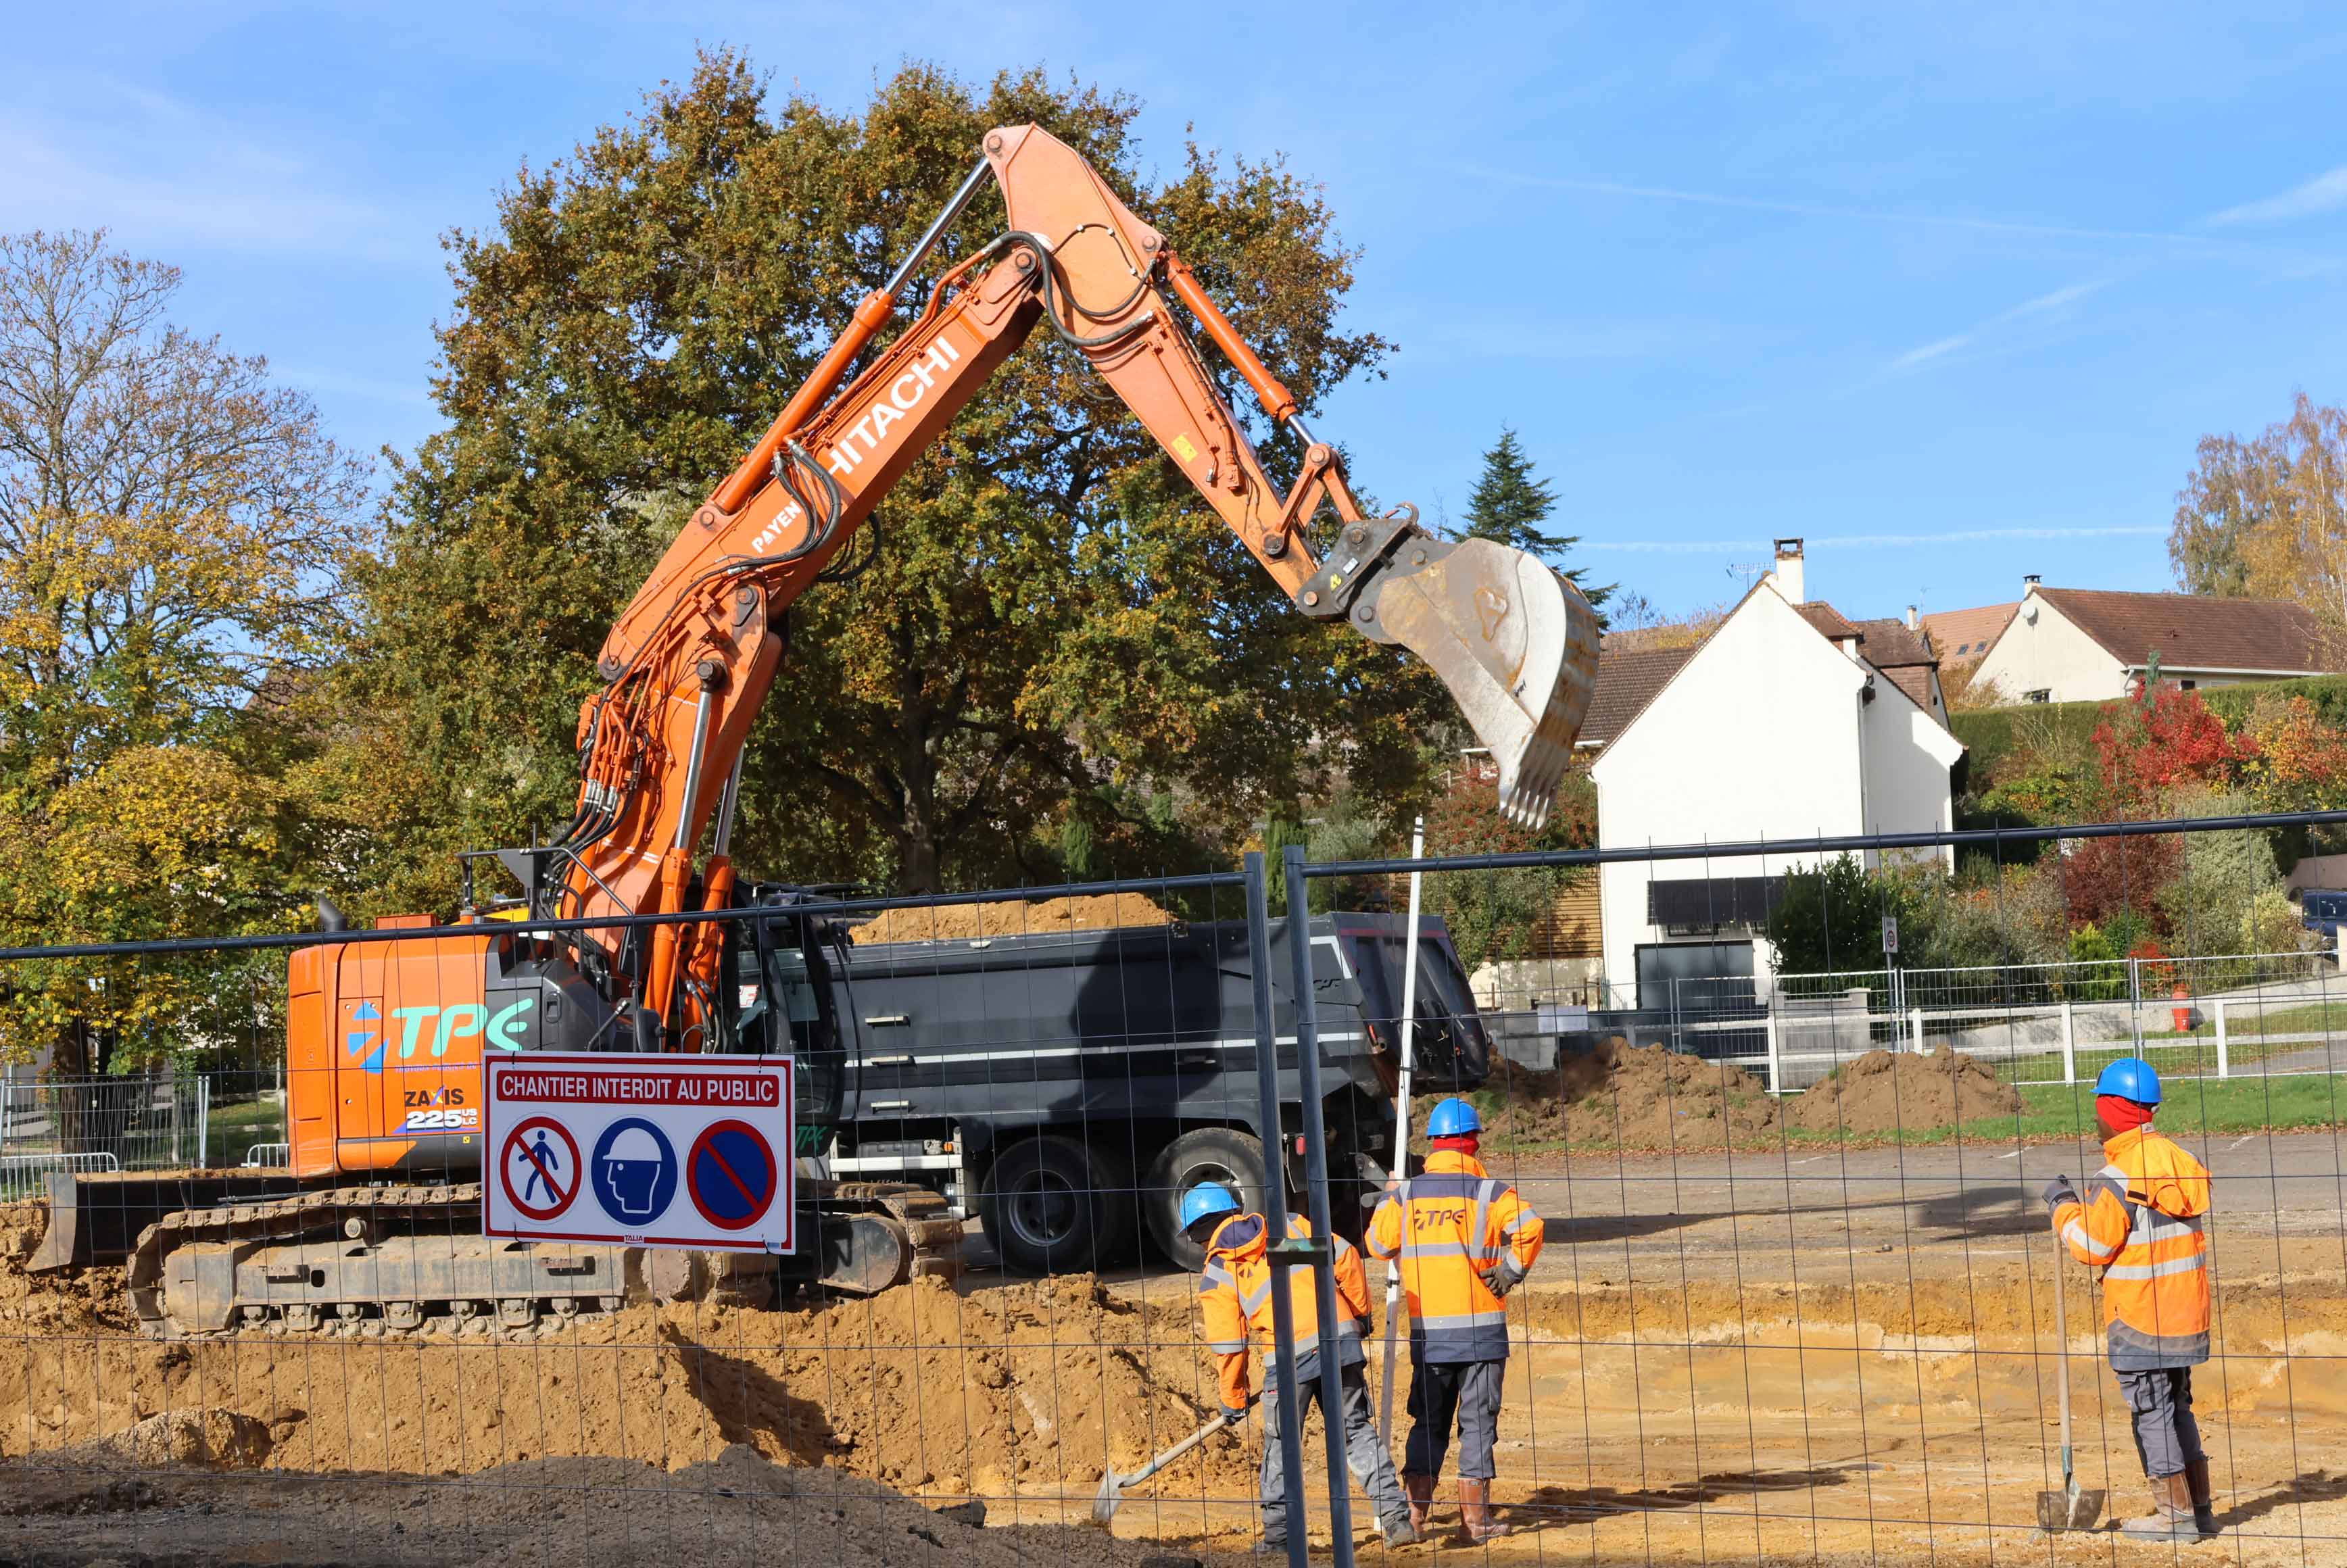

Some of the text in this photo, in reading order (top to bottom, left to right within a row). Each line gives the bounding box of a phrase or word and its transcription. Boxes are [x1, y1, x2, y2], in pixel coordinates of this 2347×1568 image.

[828, 336, 960, 474] HITACHI
[751, 500, 801, 554] PAYEN
[391, 998, 533, 1058] TPE
[405, 1084, 464, 1107] ZAXIS
[502, 1075, 773, 1102] CHANTIER INTERDIT AU PUBLIC
[406, 1108, 477, 1131] 225 US
[462, 1117, 477, 1125] LC
